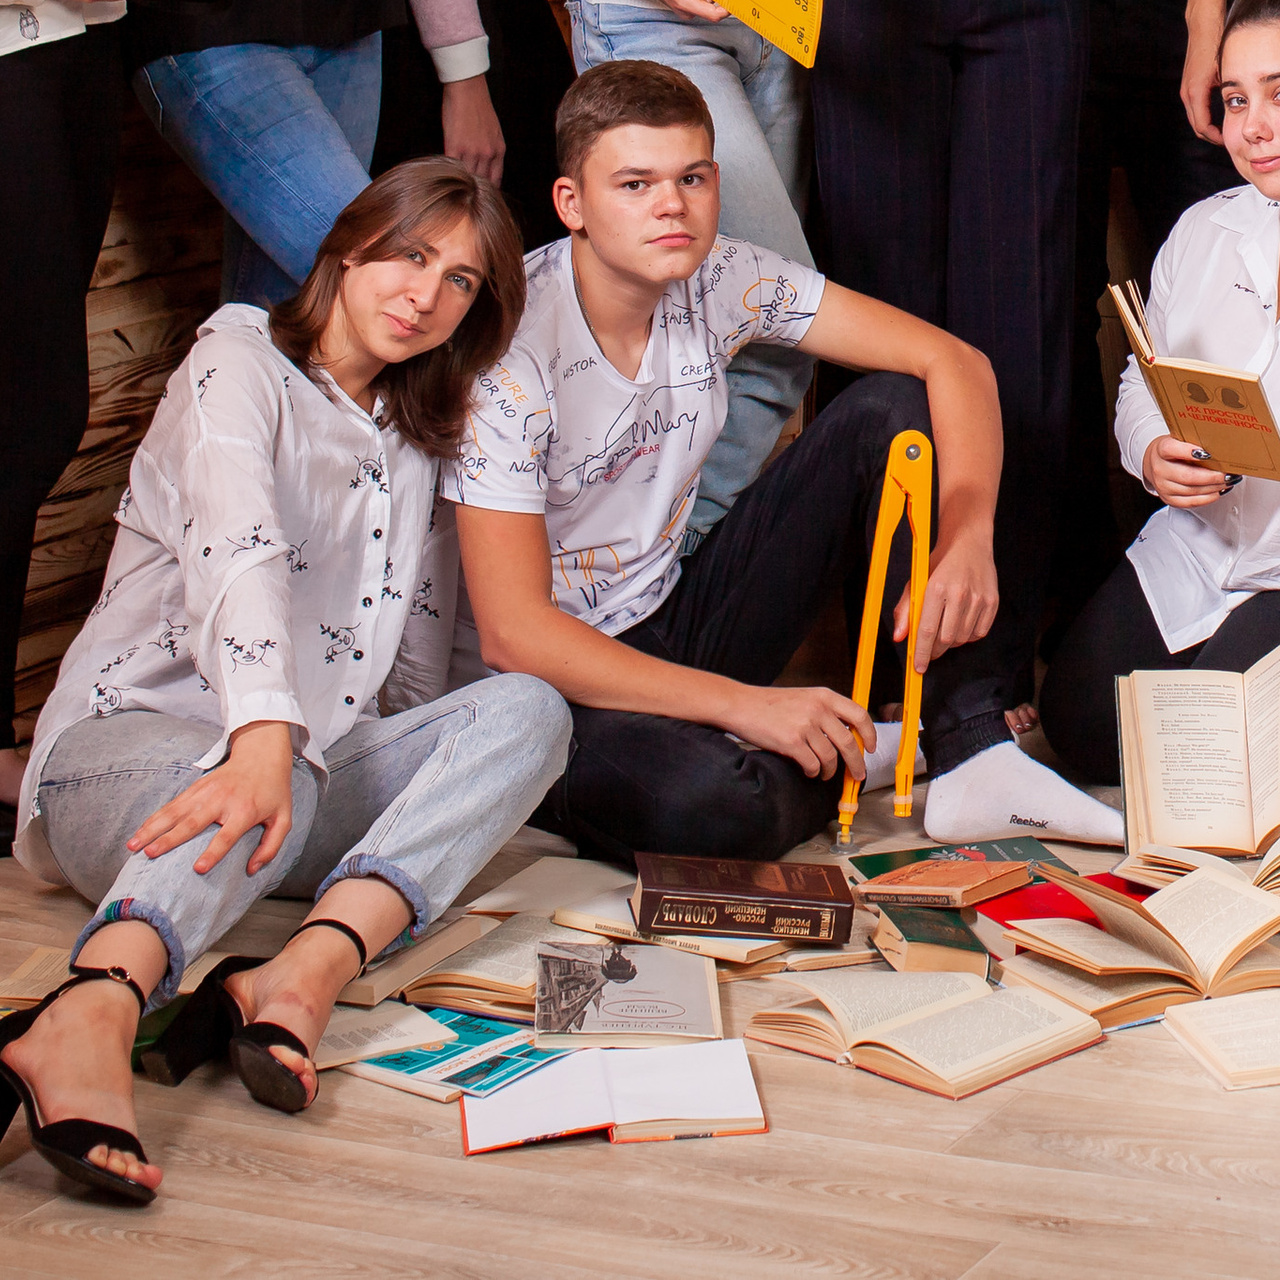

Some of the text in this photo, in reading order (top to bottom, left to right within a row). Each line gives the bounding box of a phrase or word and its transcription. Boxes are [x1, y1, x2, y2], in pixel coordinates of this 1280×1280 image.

[752, 7, 760, 19] 10
[797, 26, 805, 45] 180
[723, 245, 738, 264] NO
[762, 274, 788, 332] ERROR
[660, 312, 691, 329] JEANS
[496, 399, 517, 418] NO
[1185, 405, 1258, 423] ИХ ПРОСТОТА
[1189, 413, 1272, 434] ЧЕЛОВЕЧНОСТЬ
[509, 460, 536, 473] NO
[1009, 814, 1049, 829] Reebok
[663, 901, 717, 925] СЛОВАРЬ
[724, 903, 767, 916] НЕМЕЦКИЙ
[732, 914, 766, 924] РУССКО-
[775, 916, 811, 927] РУССКИЙ
[771, 924, 810, 936] НЕМЕЦКО-
